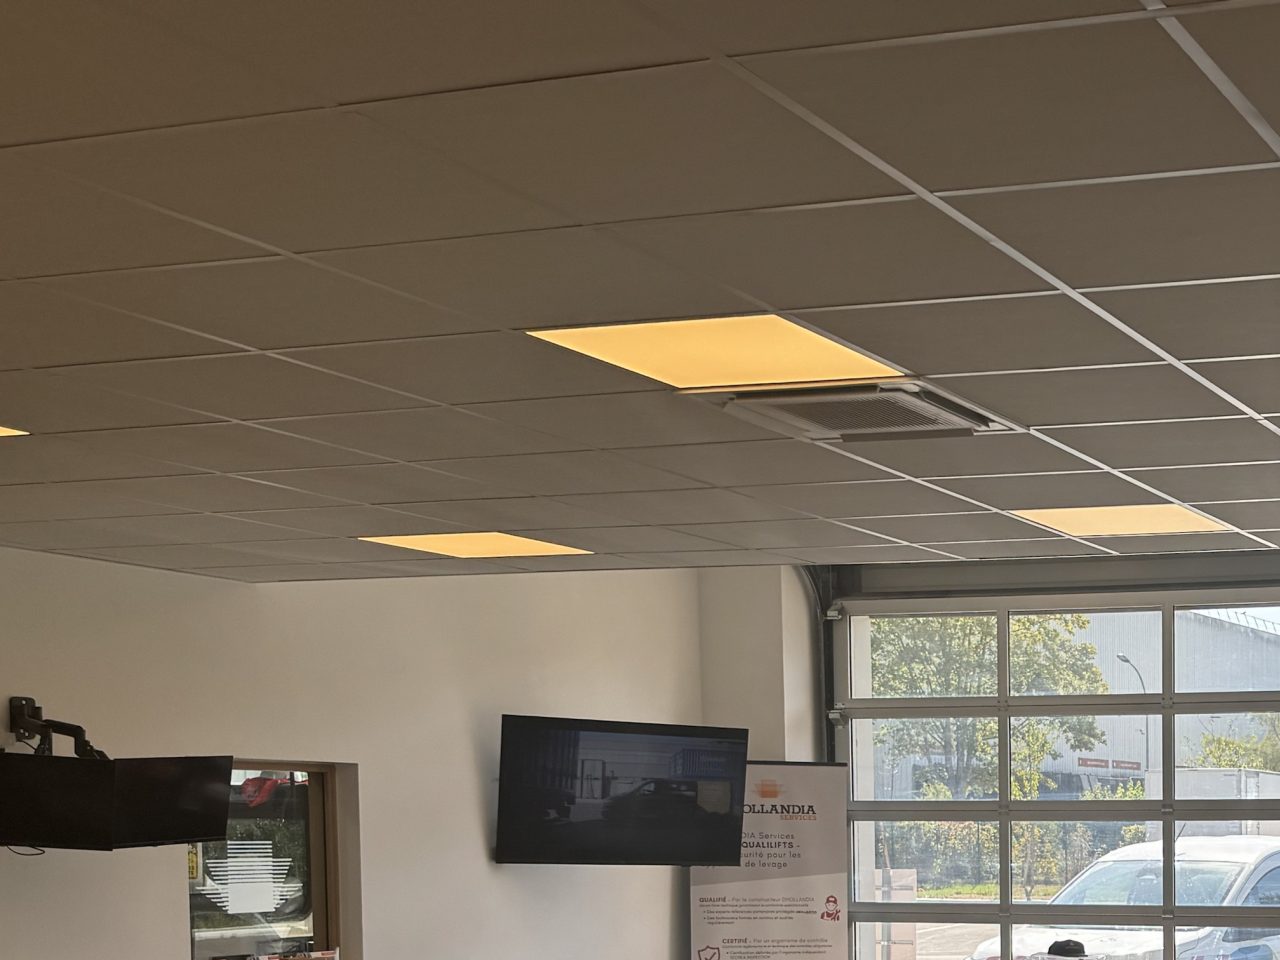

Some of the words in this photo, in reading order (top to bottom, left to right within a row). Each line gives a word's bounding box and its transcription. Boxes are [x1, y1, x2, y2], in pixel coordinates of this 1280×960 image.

[743, 803, 817, 815] OLLANDIA
[741, 841, 794, 849] QUALILIFTS
[767, 852, 786, 860] pour
[745, 860, 756, 868] de
[758, 860, 788, 869] levage
